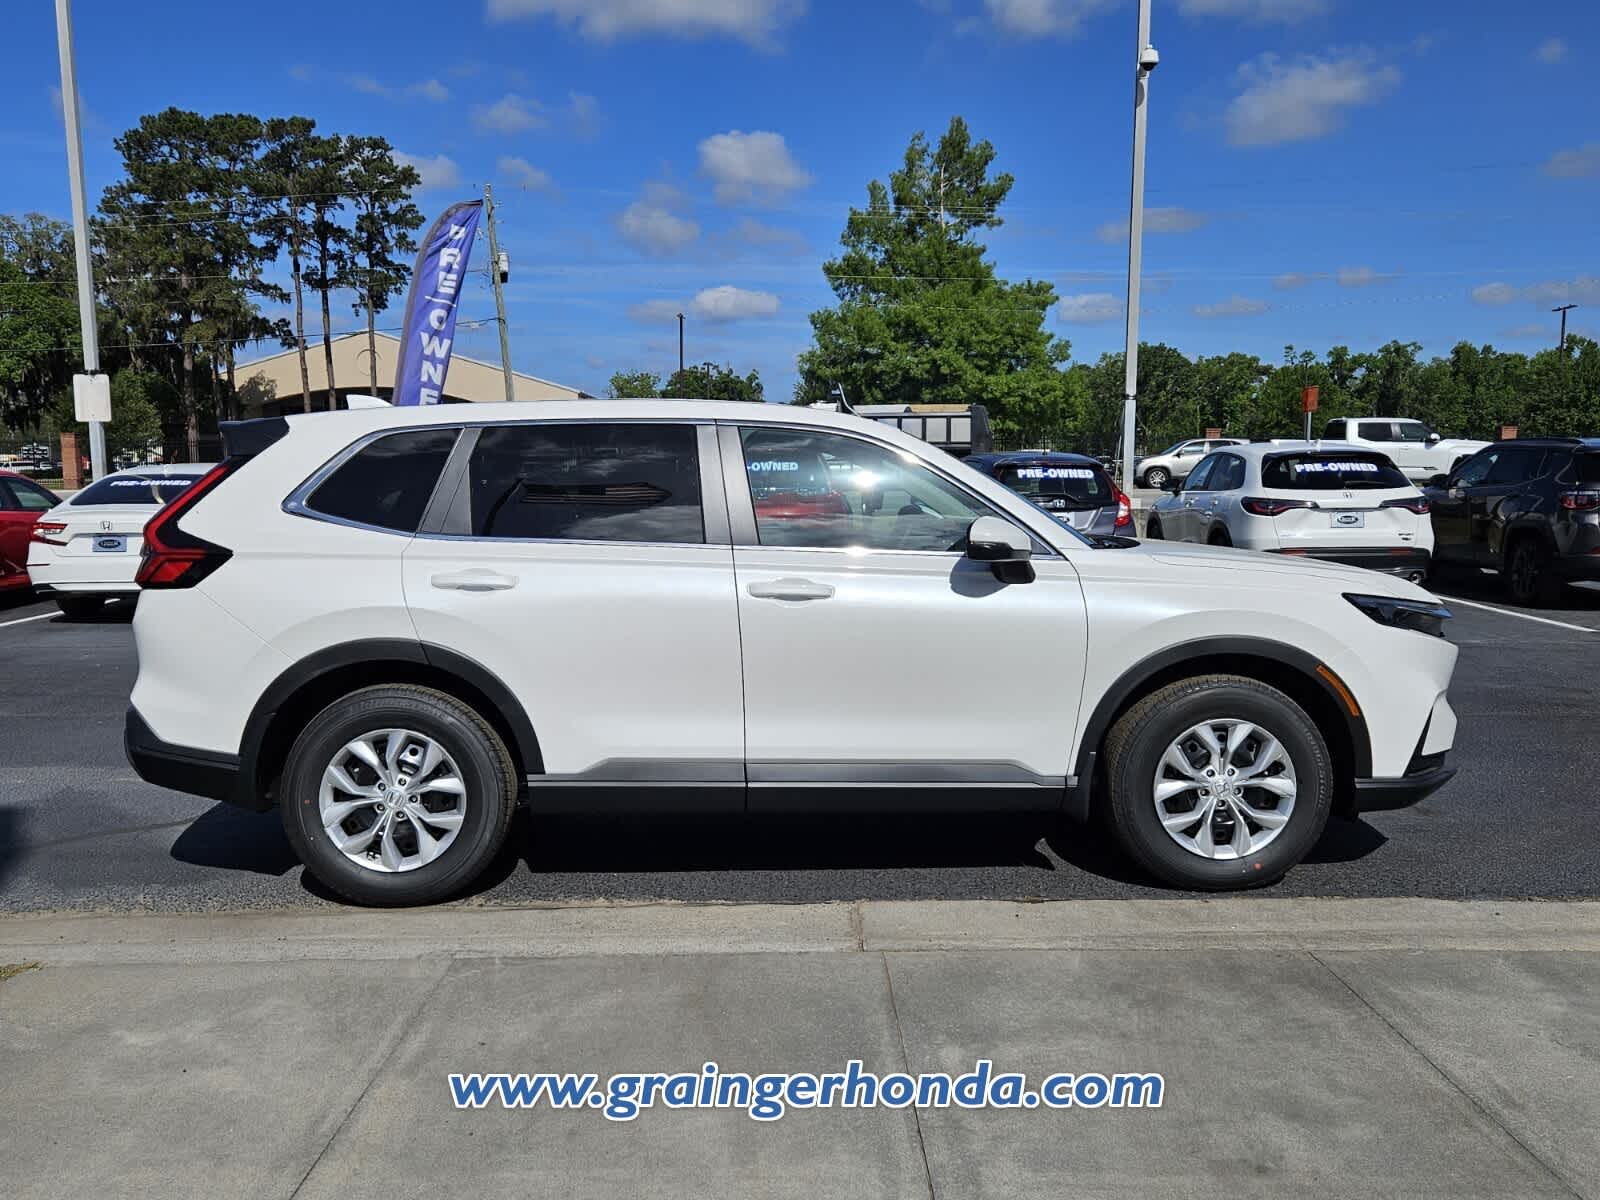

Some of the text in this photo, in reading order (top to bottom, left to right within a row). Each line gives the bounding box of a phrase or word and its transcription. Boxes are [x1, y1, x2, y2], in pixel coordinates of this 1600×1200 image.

[1295, 462, 1379, 473] PRE-OWNED
[1017, 468, 1094, 479] PRE-OWNED
[110, 479, 192, 488] PRE-OWNED
